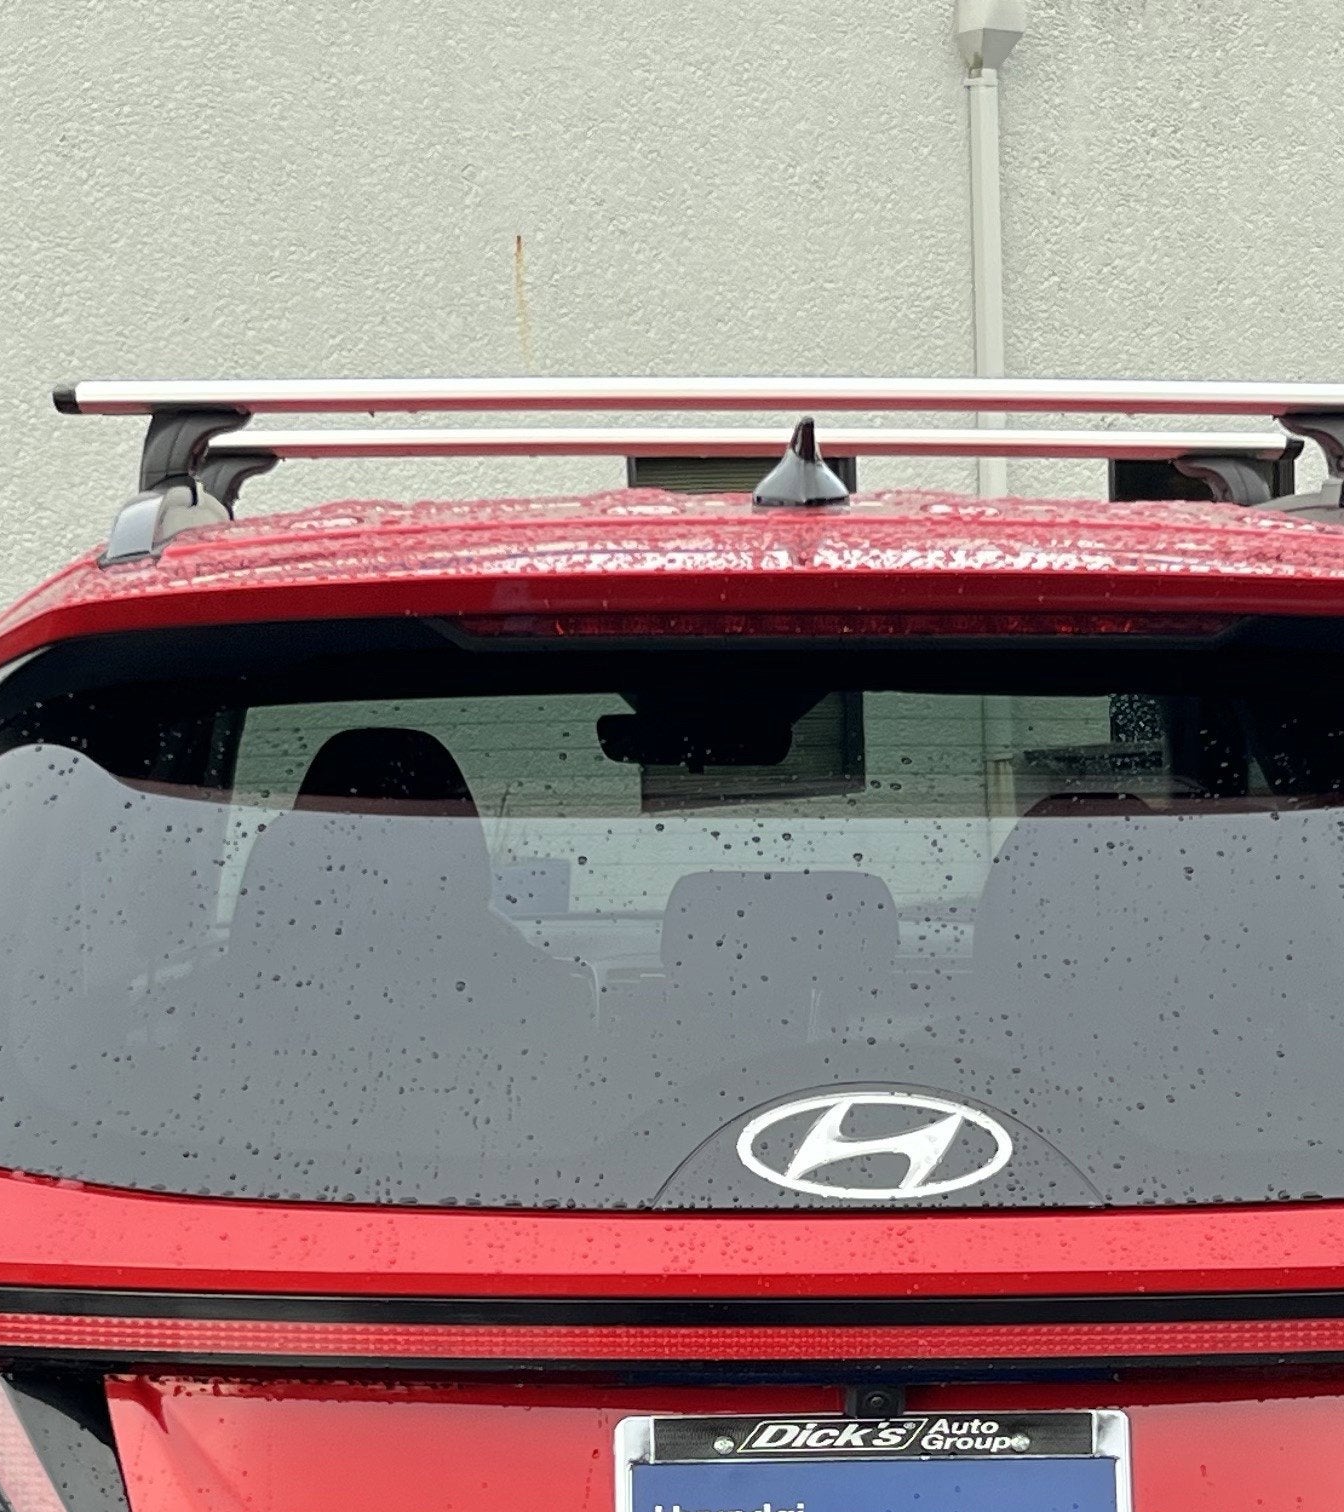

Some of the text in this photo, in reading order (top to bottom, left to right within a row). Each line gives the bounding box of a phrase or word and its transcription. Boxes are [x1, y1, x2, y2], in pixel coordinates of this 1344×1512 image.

[752, 1421, 908, 1449] Dick's
[928, 1418, 1000, 1435] Auto
[920, 1434, 1030, 1453] Group
